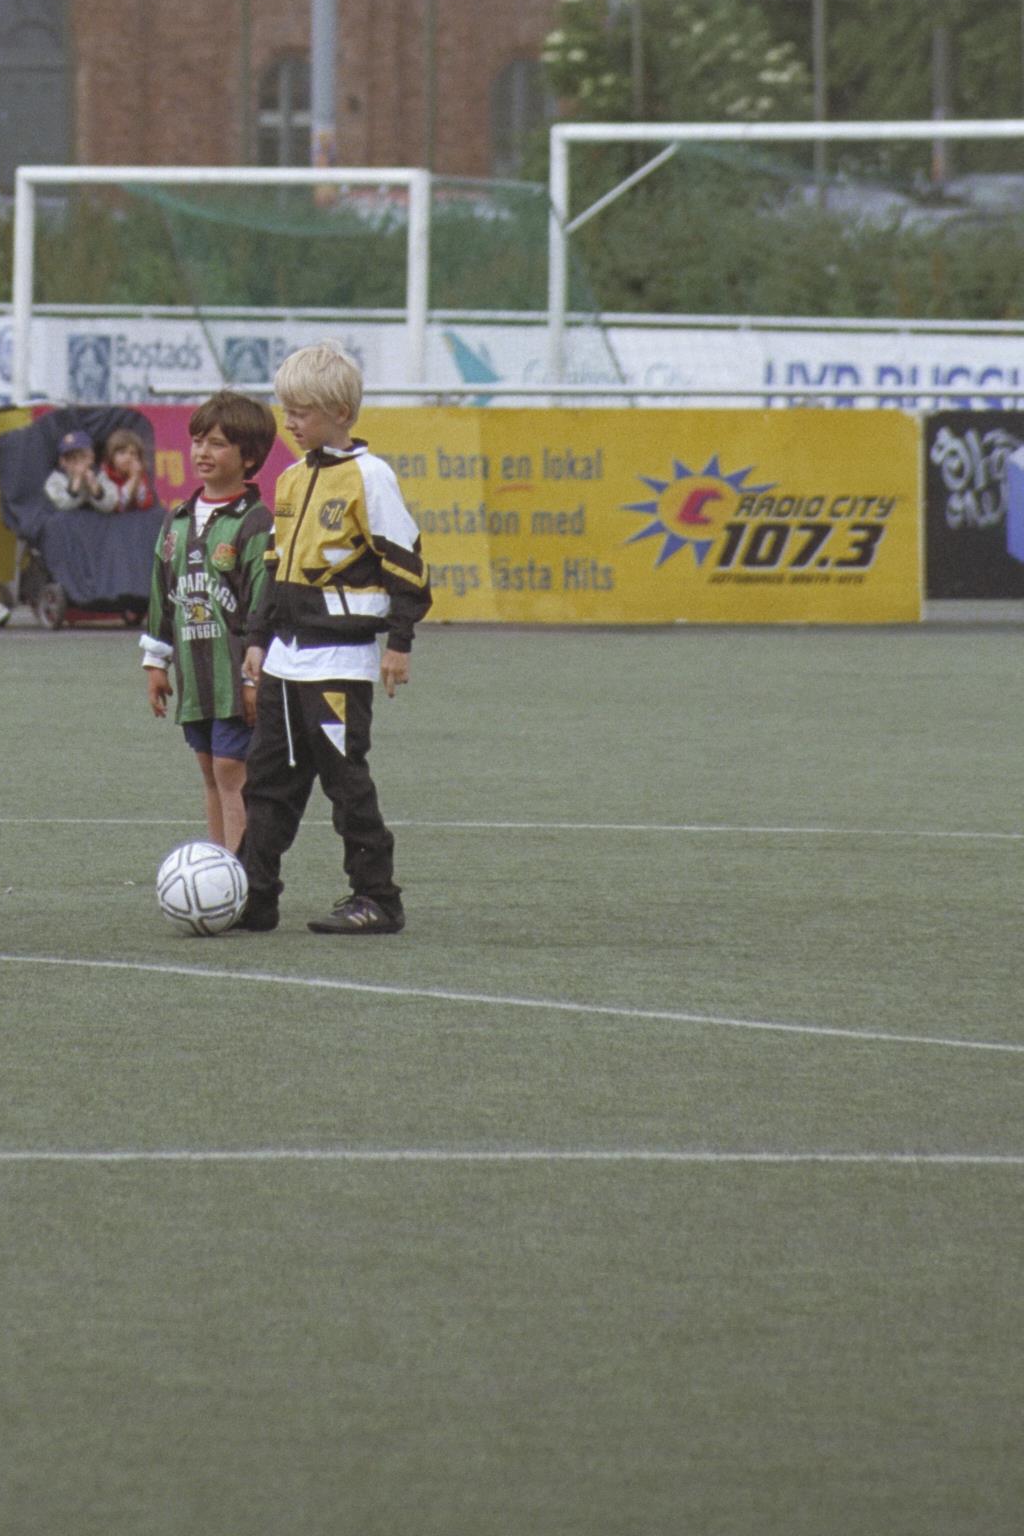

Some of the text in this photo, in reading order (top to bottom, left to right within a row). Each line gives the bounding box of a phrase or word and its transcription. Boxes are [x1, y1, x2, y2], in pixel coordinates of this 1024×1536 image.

[500, 452, 533, 480] en
[542, 445, 602, 480] lokal
[530, 504, 585, 535] med
[734, 495, 897, 519] RADIO CITY
[716, 522, 885, 570] 107.3
[562, 557, 614, 591] Hits
